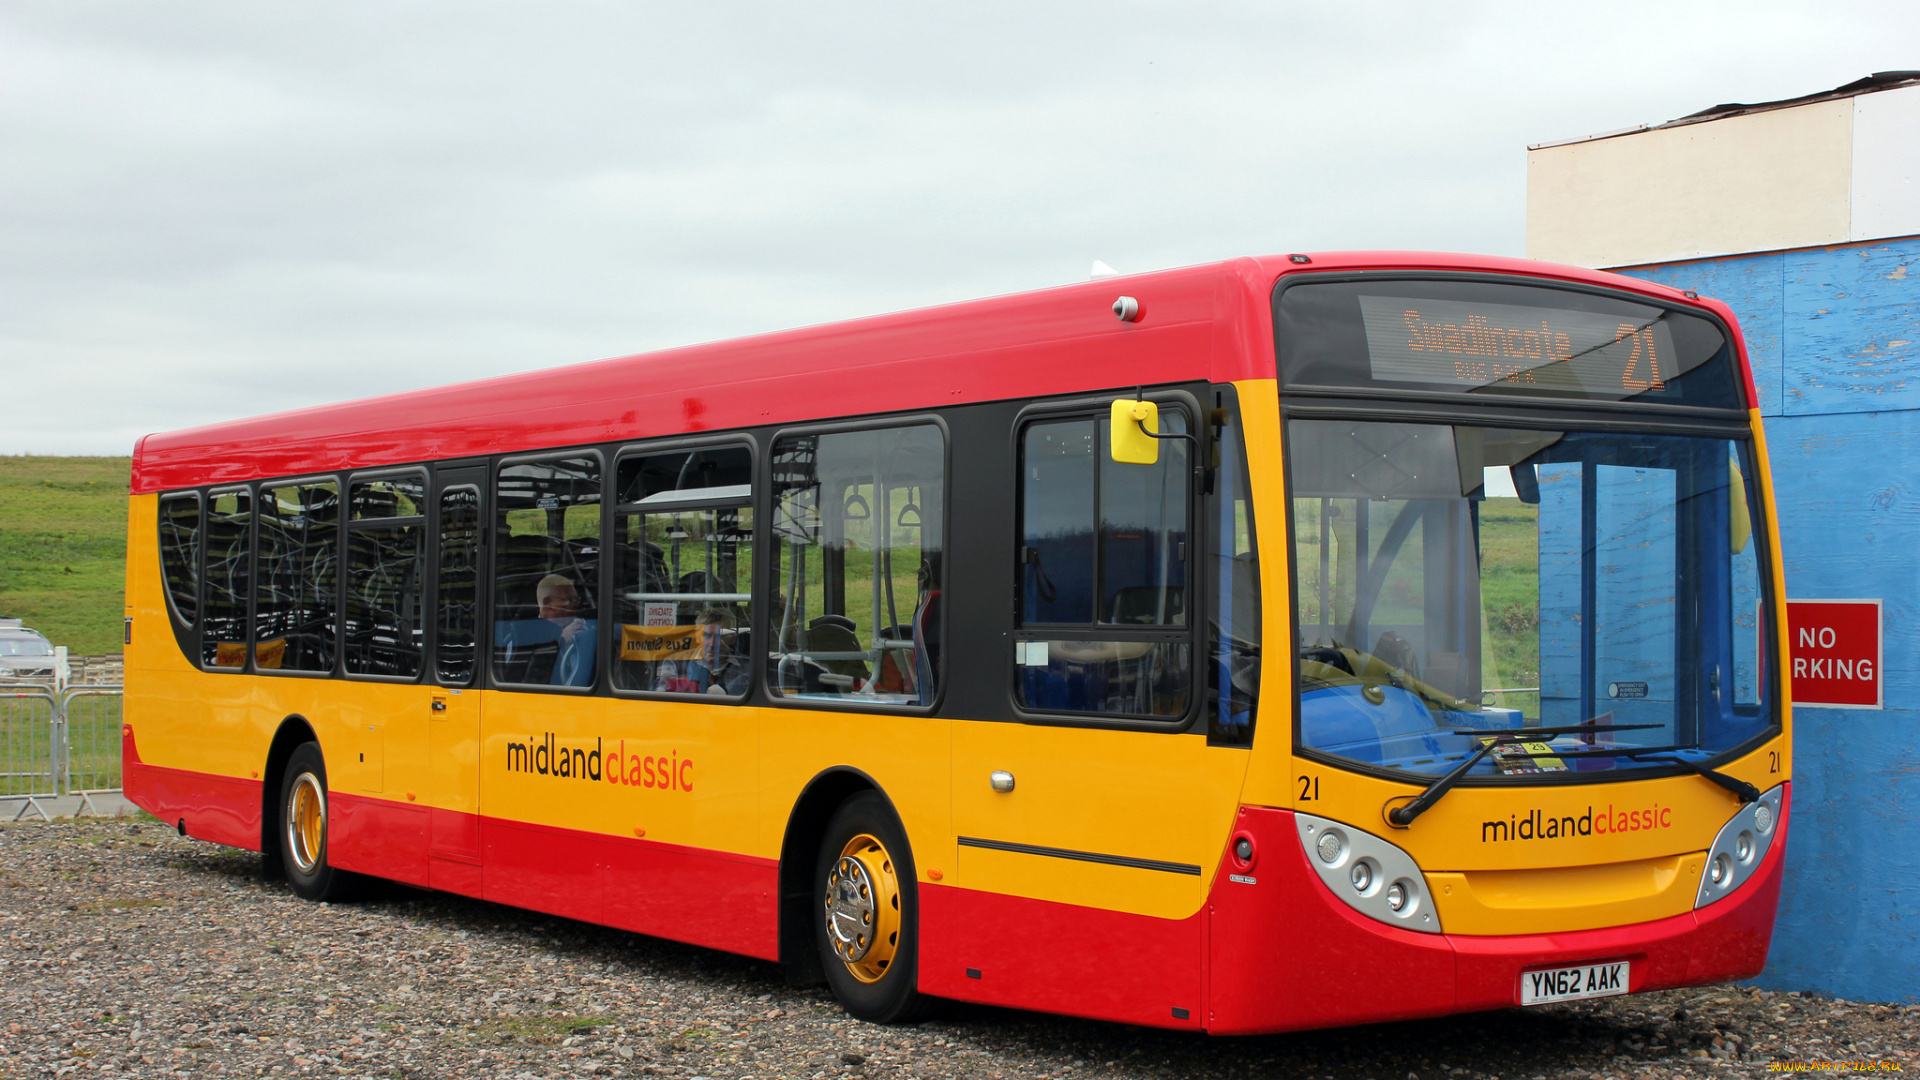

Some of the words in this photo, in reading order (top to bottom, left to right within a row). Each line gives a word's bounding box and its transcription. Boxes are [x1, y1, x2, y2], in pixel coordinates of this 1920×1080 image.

[1404, 309, 1573, 361] Swadlincote
[1614, 323, 1666, 391] 21
[1799, 627, 1836, 649] NO
[1793, 657, 1873, 681] RKING
[1768, 750, 1780, 774] 21
[1297, 775, 1319, 801] 21
[1531, 969, 1582, 997] YN62
[1586, 965, 1621, 992] AAK
